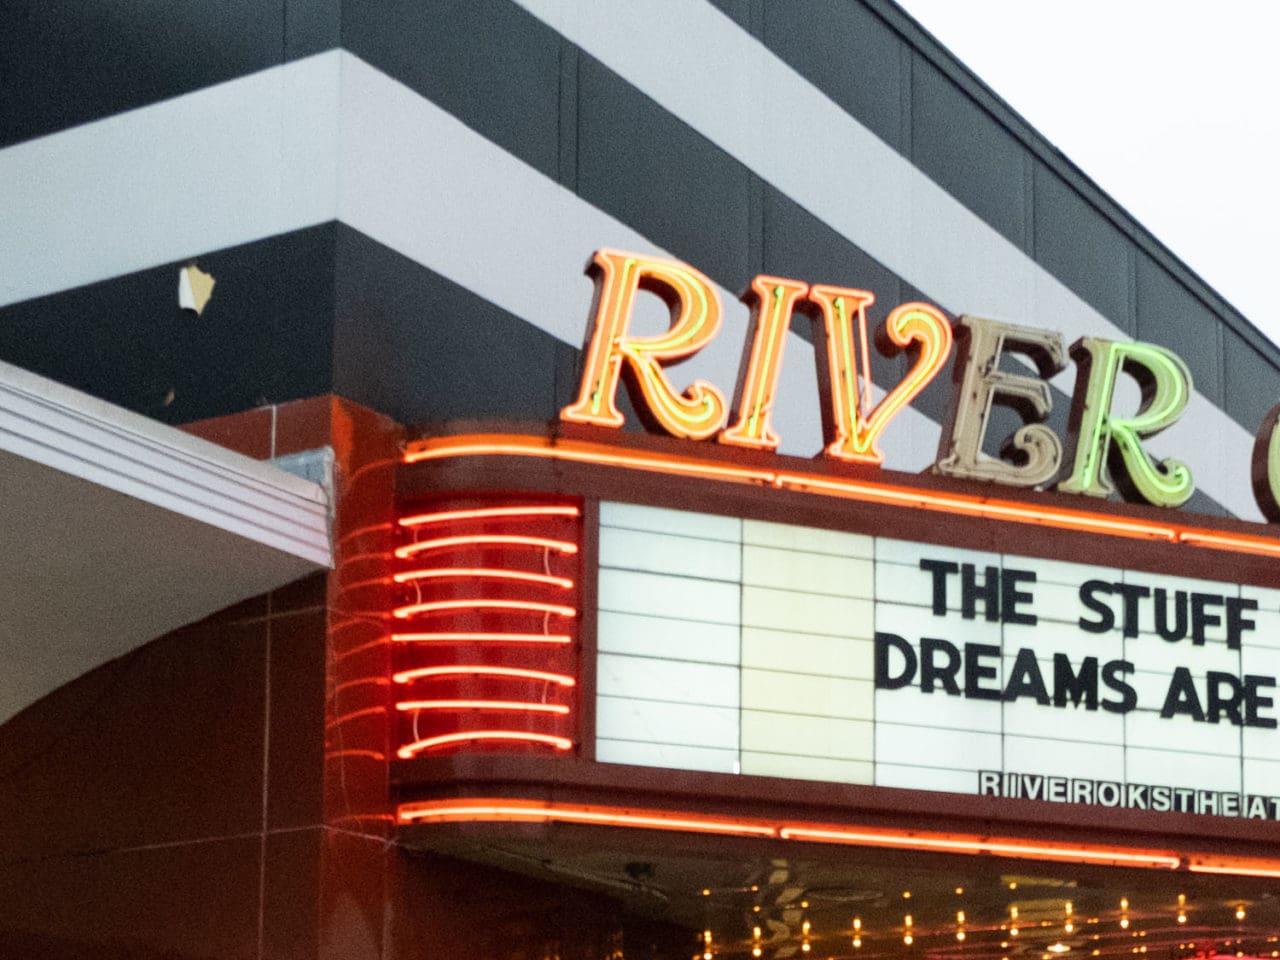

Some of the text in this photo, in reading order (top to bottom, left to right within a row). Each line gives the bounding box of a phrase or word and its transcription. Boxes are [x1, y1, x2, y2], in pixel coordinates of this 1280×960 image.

[558, 247, 1196, 508] RIVER
[919, 558, 1038, 626] THE
[1078, 578, 1259, 652] STUFF
[874, 631, 1138, 714] DREAMS
[1160, 665, 1278, 730] ARE
